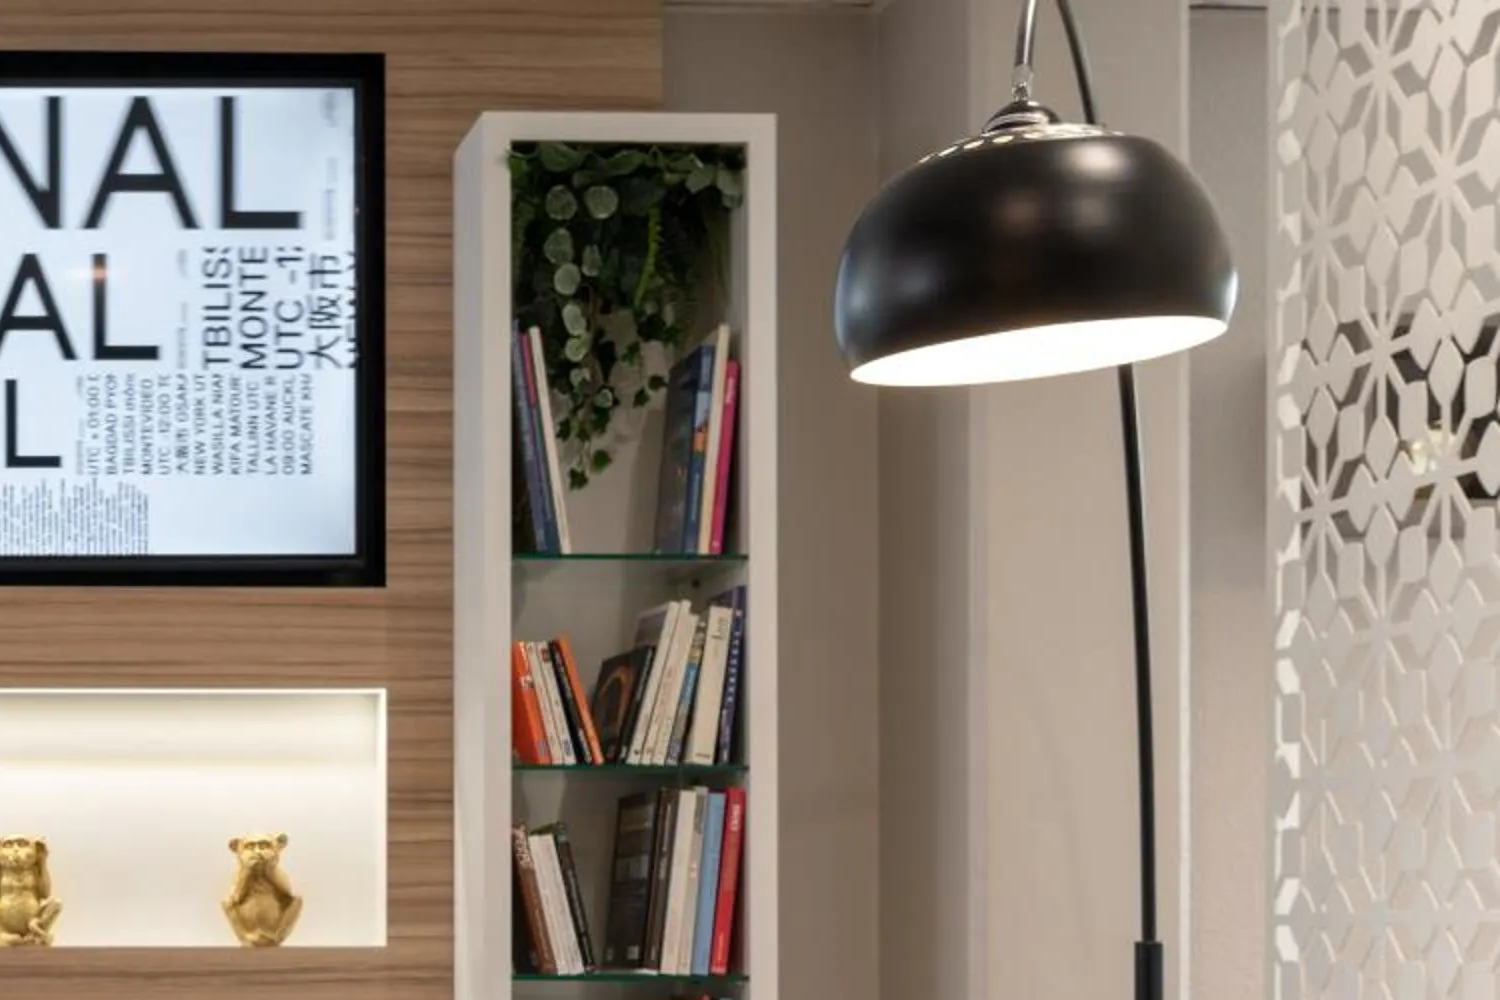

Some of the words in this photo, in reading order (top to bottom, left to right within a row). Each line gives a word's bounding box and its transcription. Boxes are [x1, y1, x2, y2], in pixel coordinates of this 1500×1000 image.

[238, 247, 268, 370] MONTE
[274, 300, 304, 370] UTC
[192, 397, 207, 435] YORK
[246, 382, 260, 411] UTC
[264, 392, 278, 451] HAVANE
[140, 378, 154, 476] MONTEVIDEO
[210, 409, 225, 476] WASILLA
[246, 415, 260, 474] TALLINN
[299, 407, 313, 476] MASCATE
[192, 441, 207, 476] NEW
[228, 442, 243, 476] KIFA
[264, 456, 278, 476] LA
